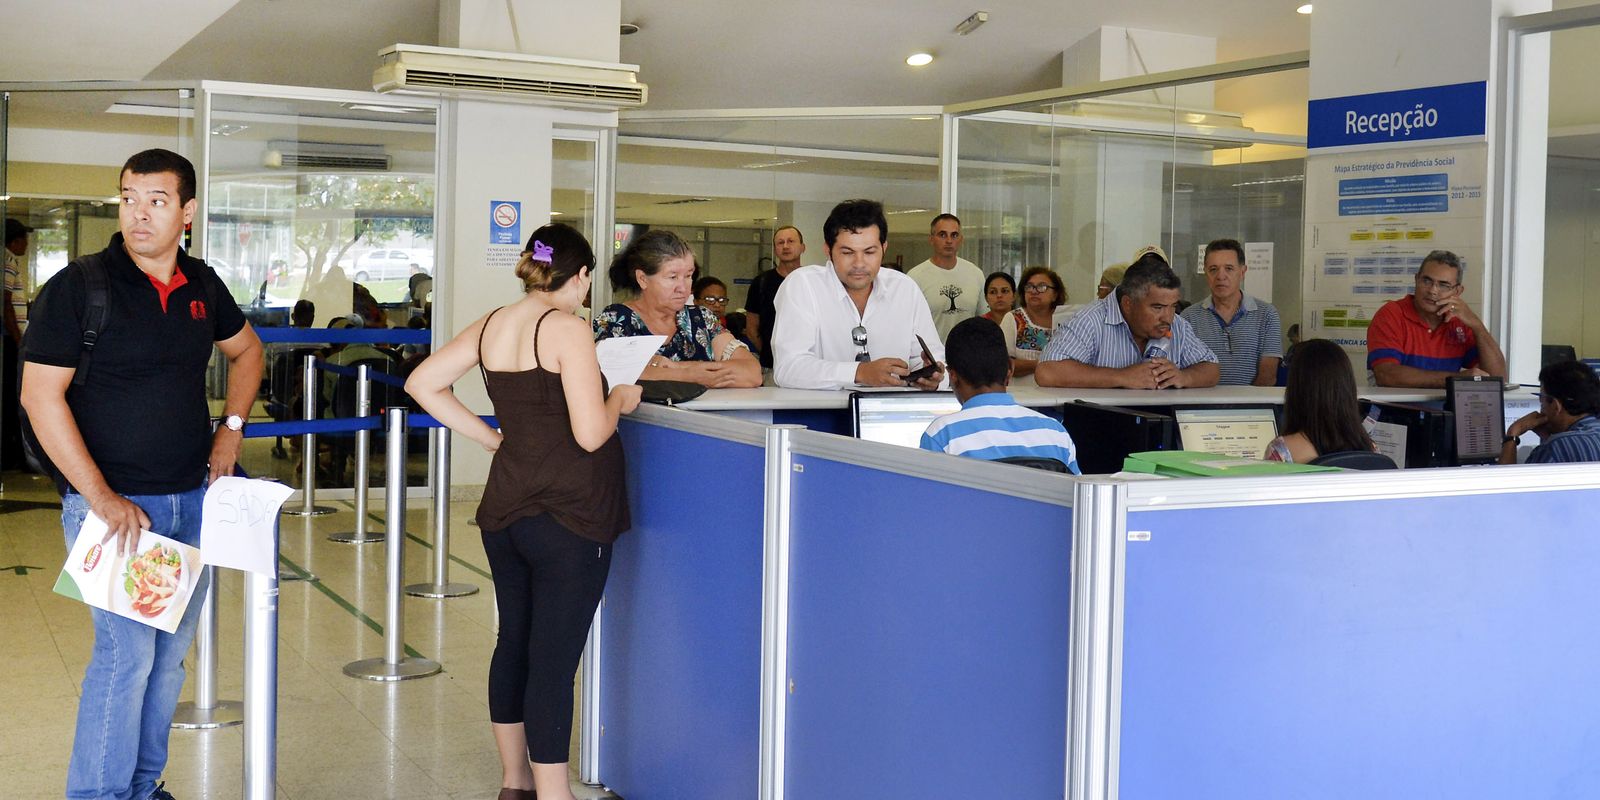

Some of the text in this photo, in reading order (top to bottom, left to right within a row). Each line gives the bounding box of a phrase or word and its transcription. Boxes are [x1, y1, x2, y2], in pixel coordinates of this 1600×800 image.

[1345, 103, 1438, 137] Recepção
[1334, 156, 1455, 173] Mapa Estratégico da Previdência Social
